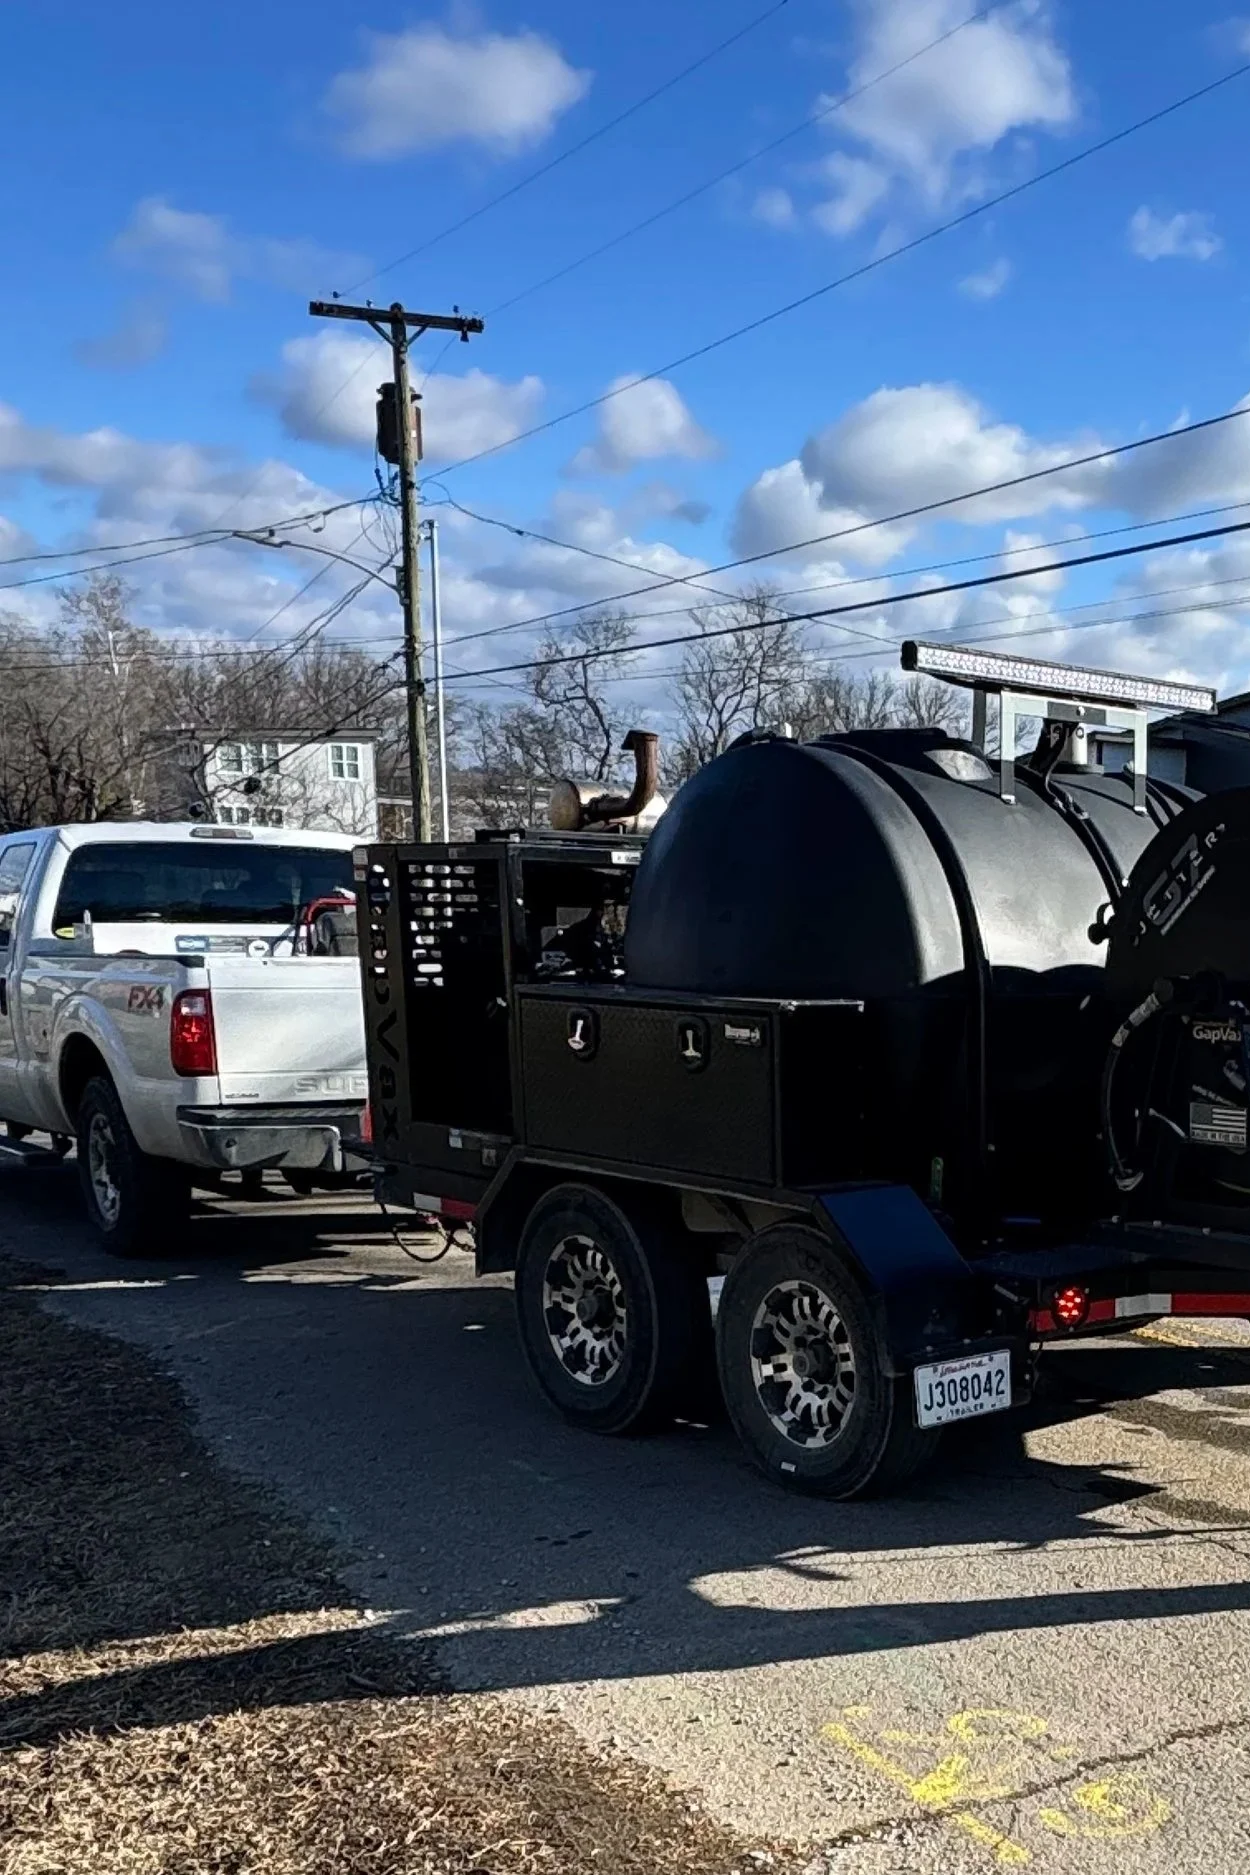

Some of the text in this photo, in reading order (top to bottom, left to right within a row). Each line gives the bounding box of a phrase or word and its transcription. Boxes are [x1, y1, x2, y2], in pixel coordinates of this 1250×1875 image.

[128, 985, 166, 1011] FX4
[924, 1368, 1005, 1411] J308042
[948, 1402, 985, 1418] TRAILER
